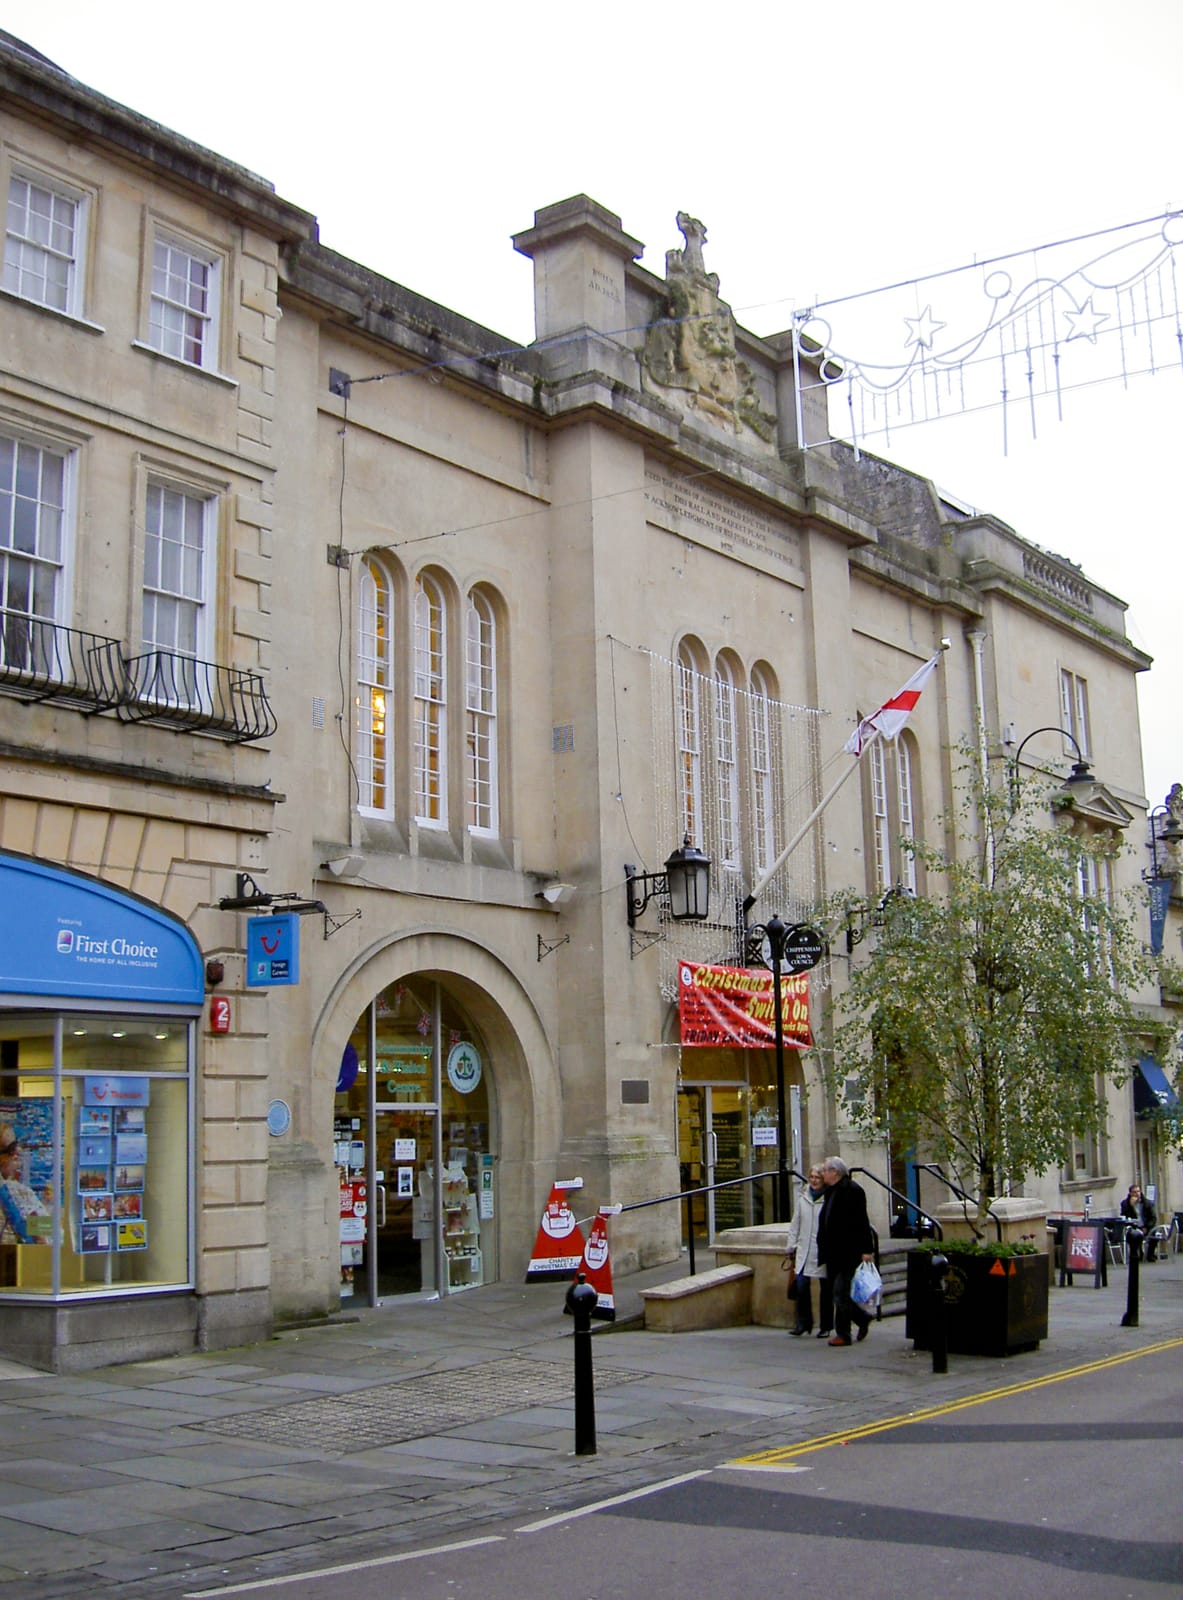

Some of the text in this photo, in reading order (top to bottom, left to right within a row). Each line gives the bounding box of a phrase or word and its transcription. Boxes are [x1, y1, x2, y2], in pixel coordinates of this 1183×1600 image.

[75, 935, 159, 958] First Choice
[694, 966, 808, 999] Christmas Lghts
[217, 1001, 229, 1021] 2
[745, 996, 789, 1020] Swith
[793, 998, 808, 1021] On
[684, 1030, 720, 1043] FRIDAY
[1071, 1244, 1093, 1258] hot
